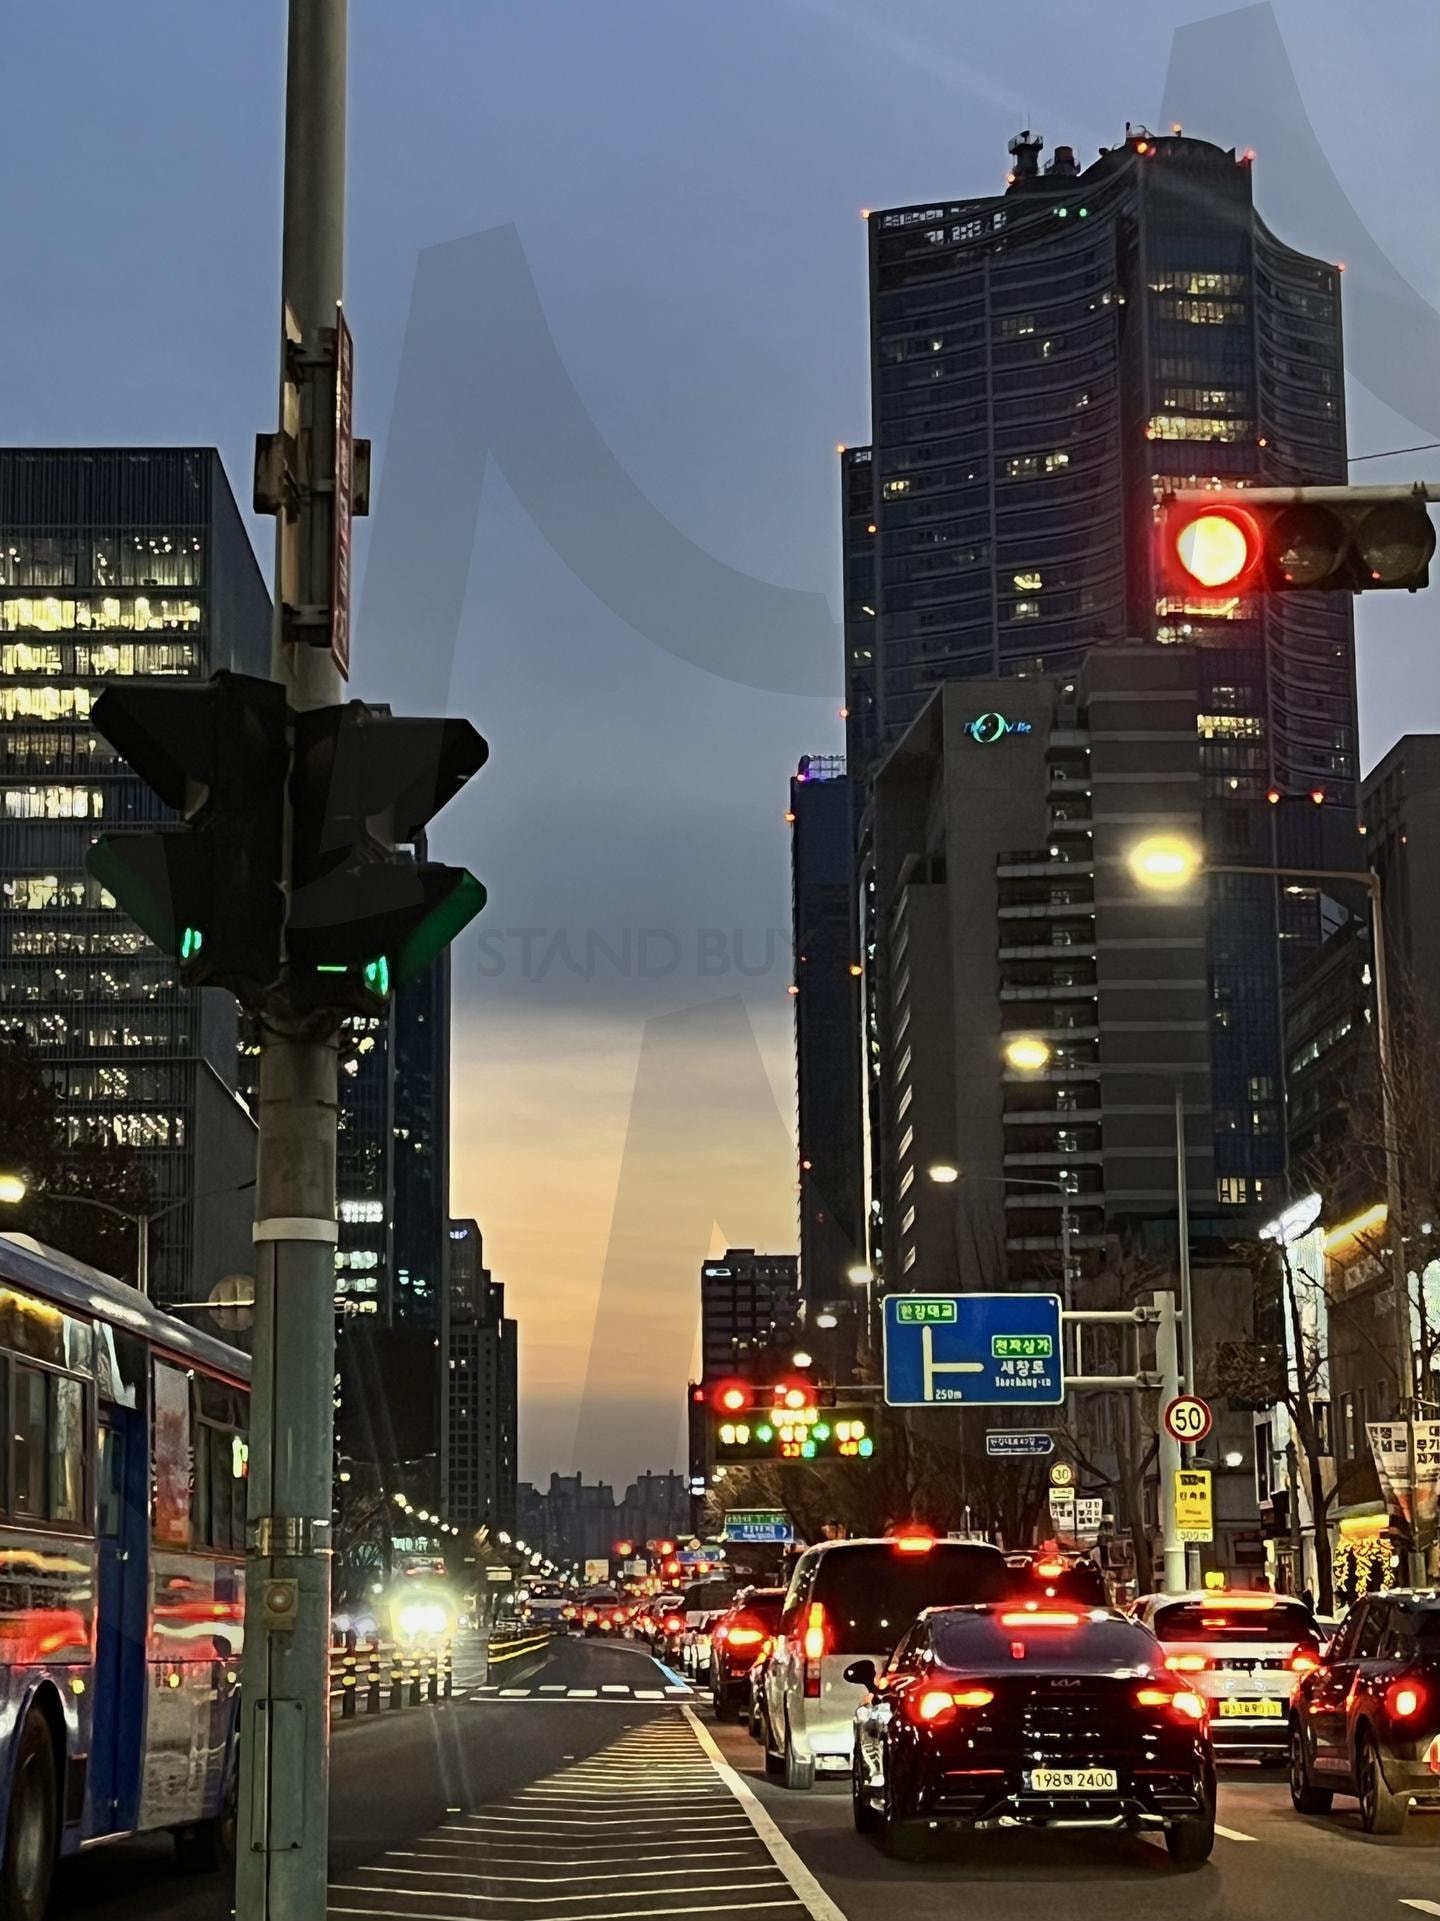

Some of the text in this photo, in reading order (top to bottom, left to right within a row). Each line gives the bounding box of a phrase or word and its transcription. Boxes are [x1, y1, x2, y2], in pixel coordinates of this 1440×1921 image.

[995, 1339, 1050, 1354] 전자상가
[935, 1388, 962, 1400] 250m
[1175, 1407, 1201, 1431] 50
[1054, 1468, 1069, 1480] 30
[1077, 1772, 1113, 1788] 2400
